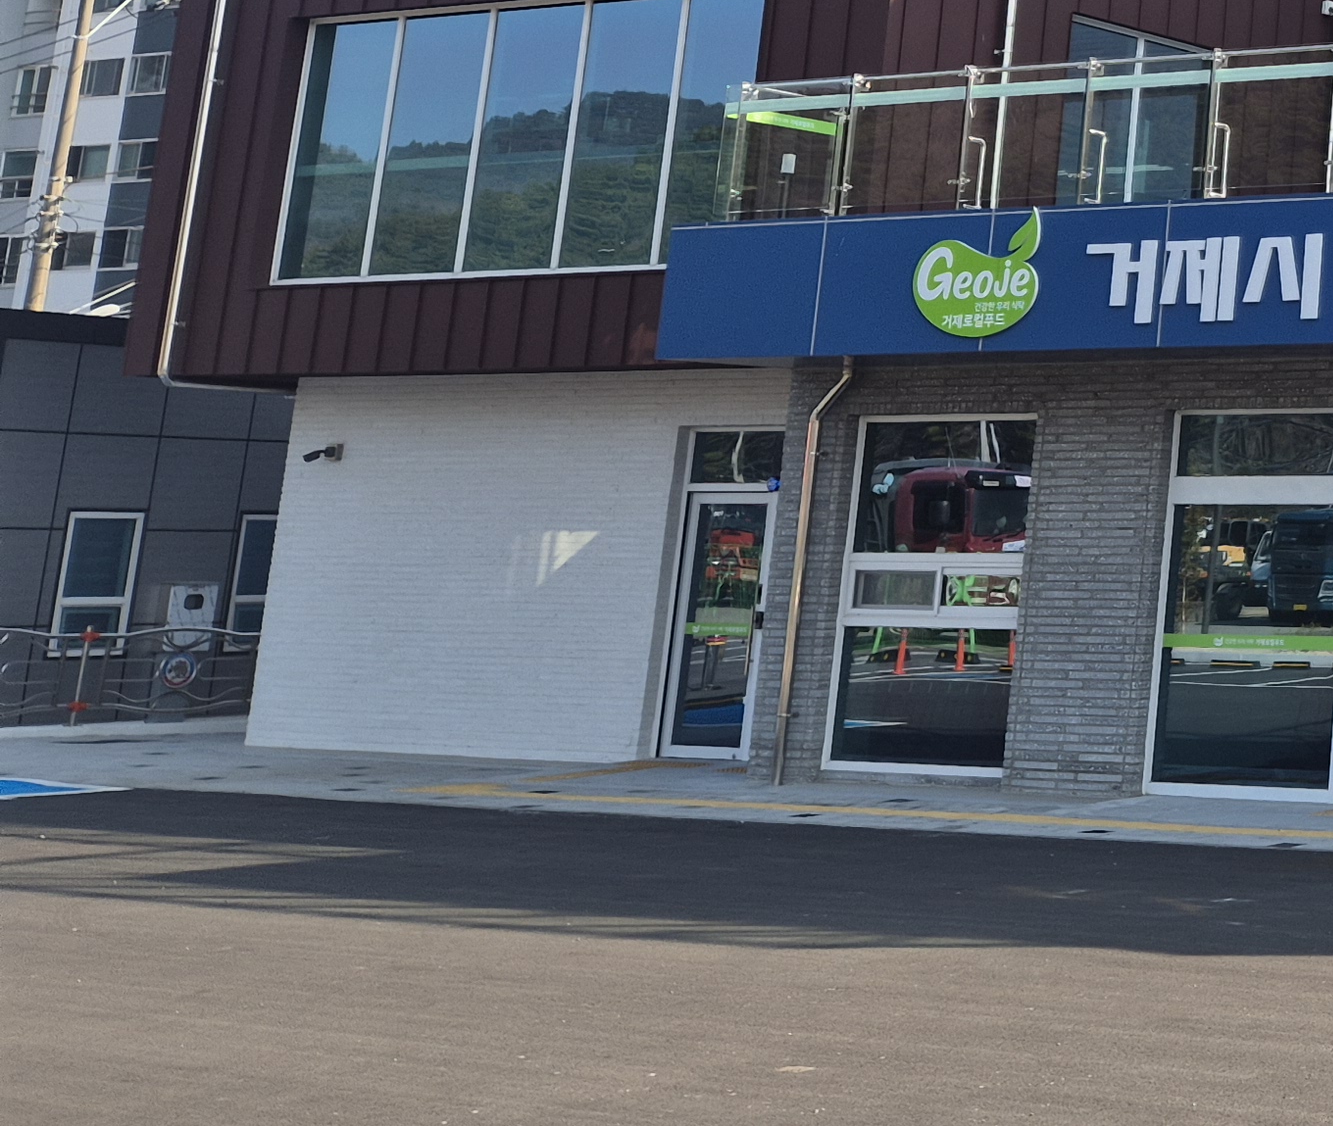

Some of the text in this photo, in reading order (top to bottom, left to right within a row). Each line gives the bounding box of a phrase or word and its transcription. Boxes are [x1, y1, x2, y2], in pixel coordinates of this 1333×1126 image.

[917, 247, 1031, 301] Geoje
[1086, 233, 1324, 324] 거제시
[942, 313, 1006, 329] 거제로컬푸드
[974, 302, 996, 312] 건강한
[996, 301, 1010, 311] 우리
